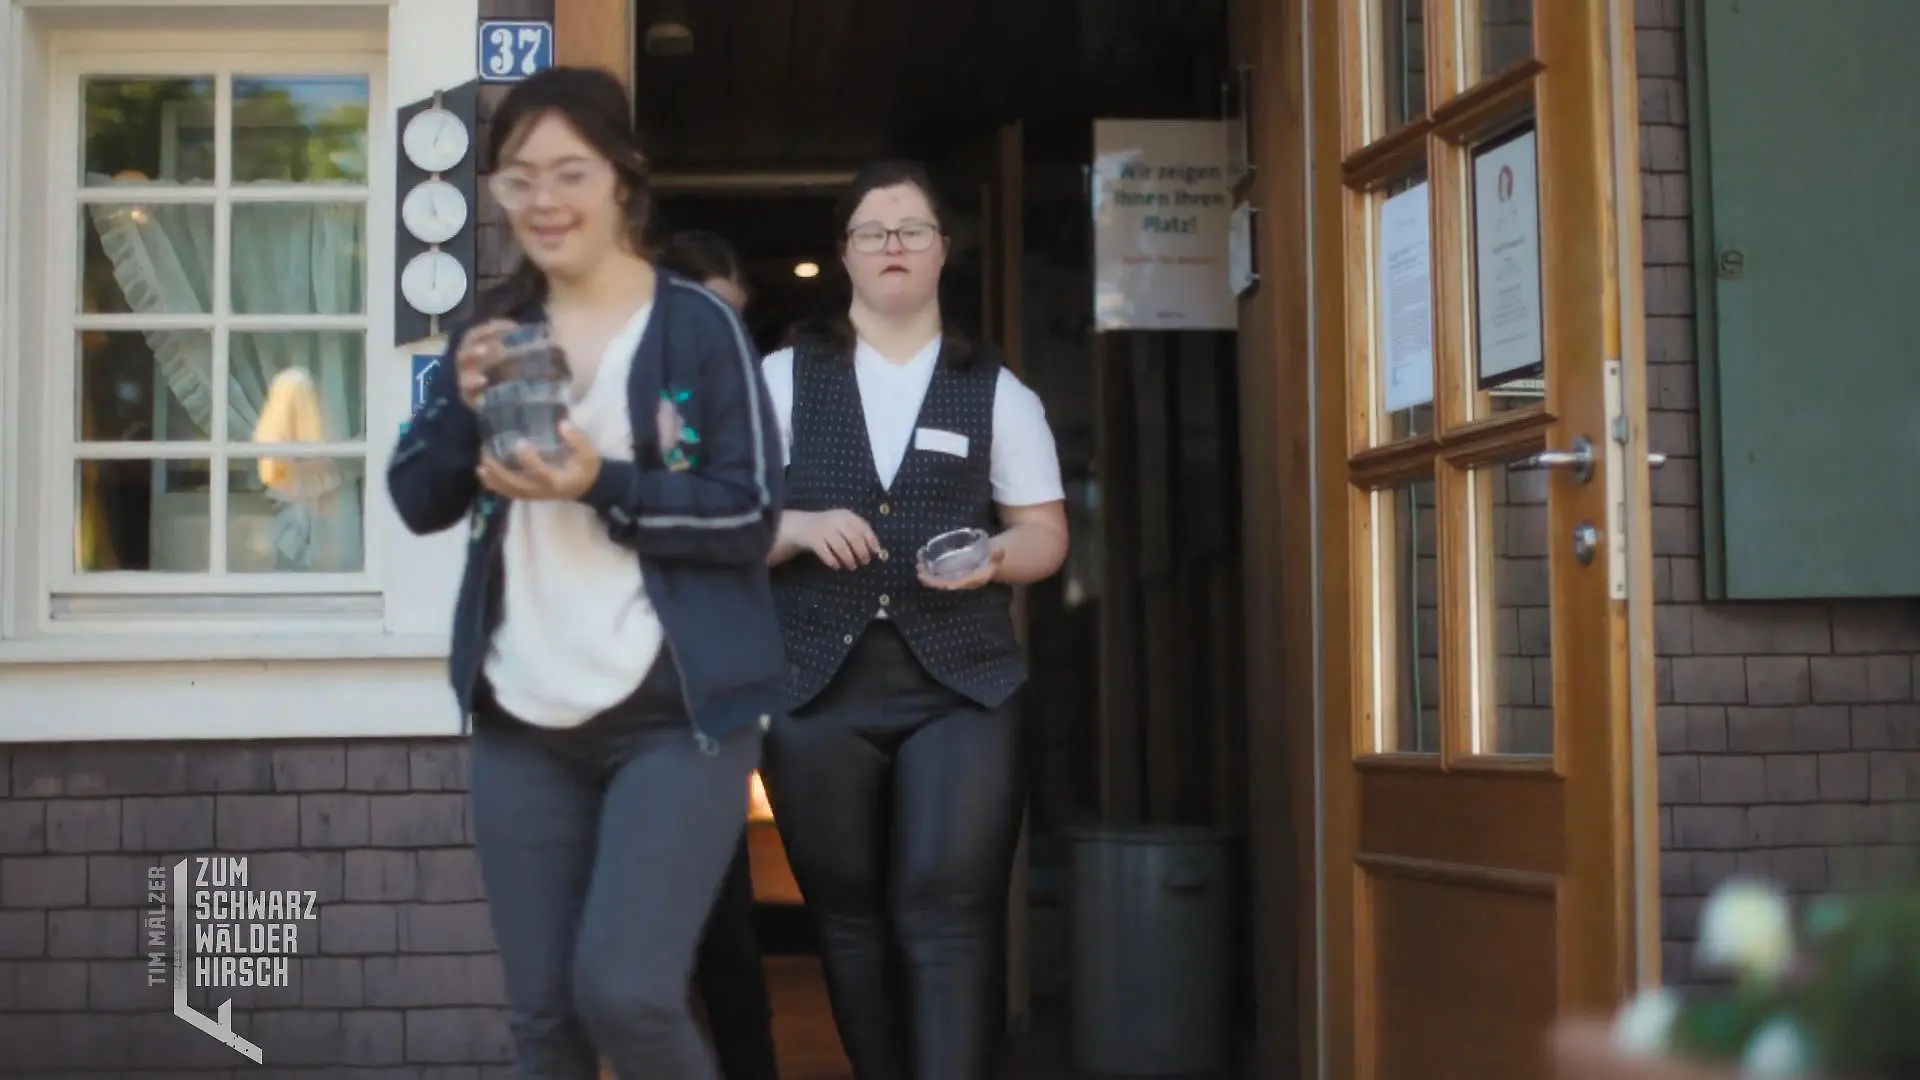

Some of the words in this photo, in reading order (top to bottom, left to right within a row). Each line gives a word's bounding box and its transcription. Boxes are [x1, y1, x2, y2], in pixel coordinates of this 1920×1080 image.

[490, 28, 532, 75] 37
[1158, 163, 1221, 185] zeigen
[1142, 215, 1197, 234] Platz!
